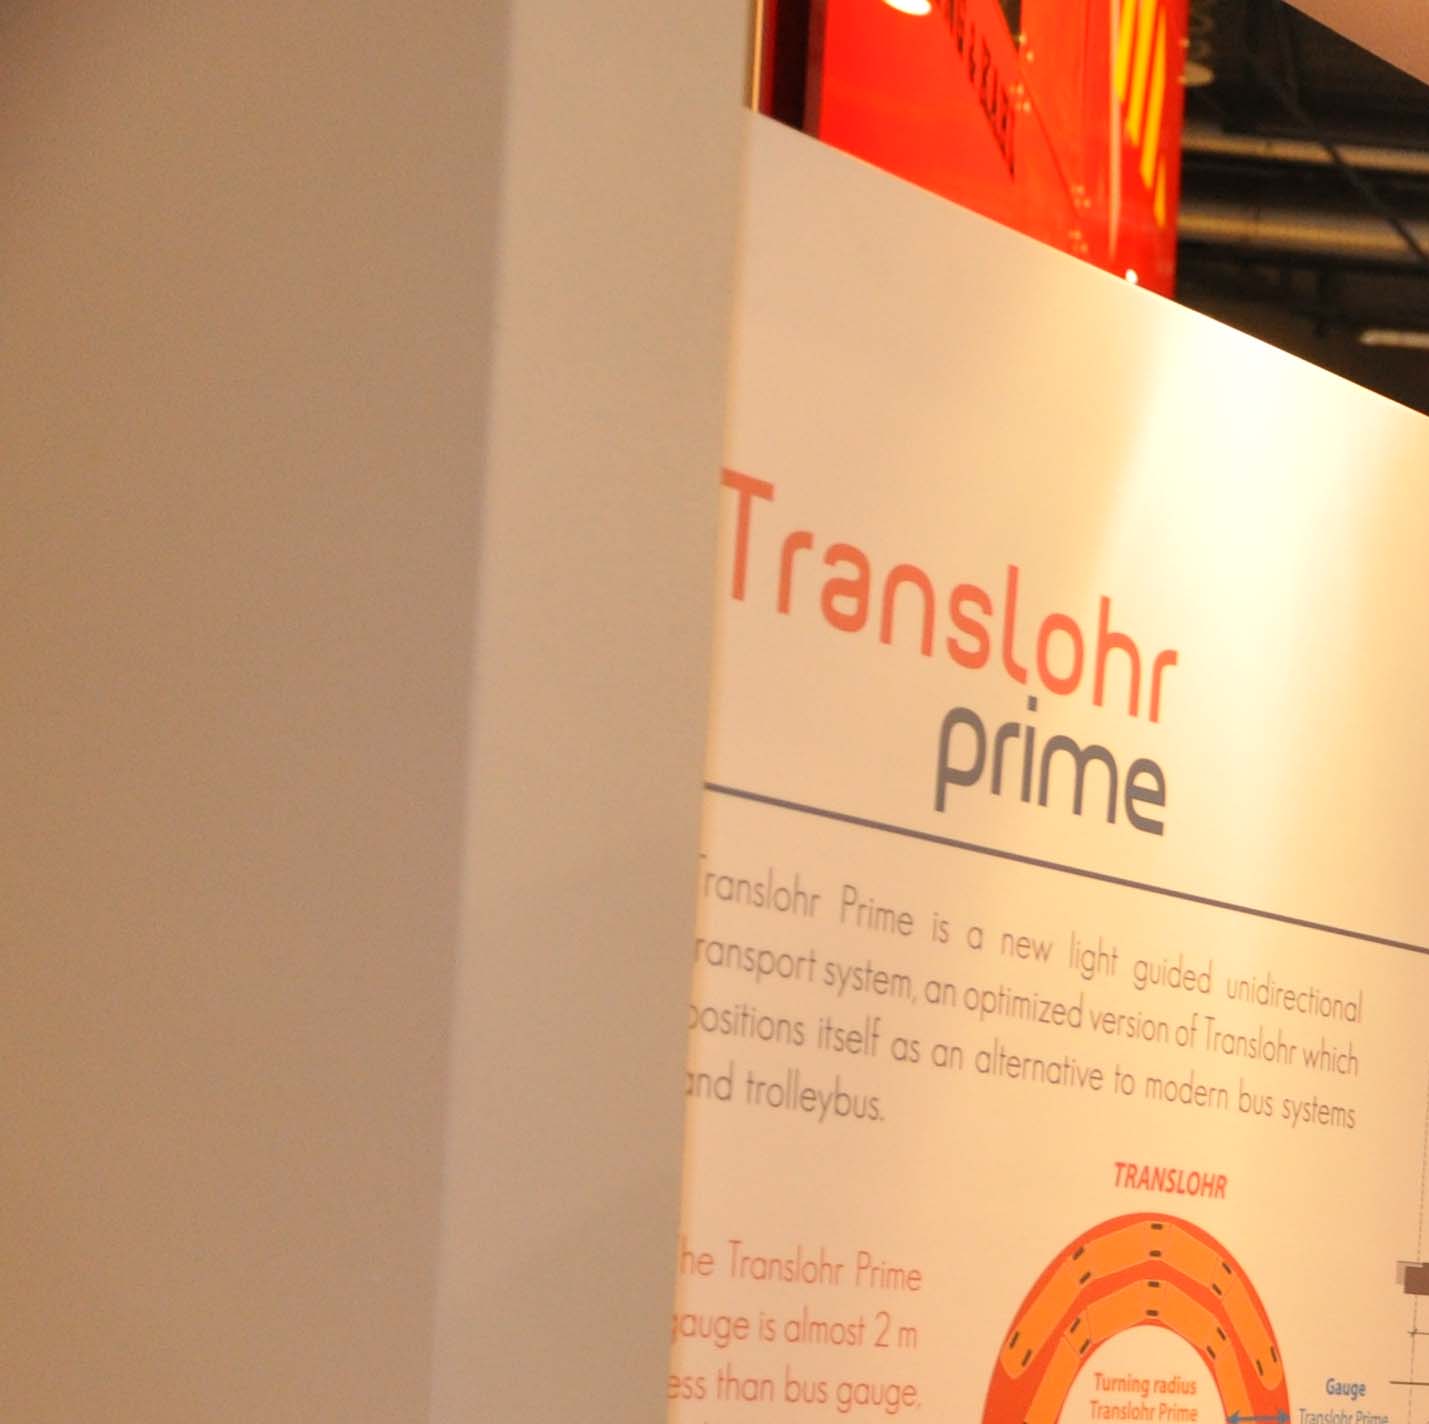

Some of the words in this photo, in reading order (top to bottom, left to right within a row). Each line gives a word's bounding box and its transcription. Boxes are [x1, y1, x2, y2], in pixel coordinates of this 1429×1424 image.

[720, 465, 1179, 724] Translohr
[933, 695, 1168, 836] prime
[699, 853, 822, 918] ranslohr
[840, 884, 914, 937] Prime
[931, 911, 951, 944] is
[966, 926, 984, 951] a
[1000, 931, 1053, 961] new
[1069, 929, 1119, 981] light
[1133, 952, 1214, 995] guided
[1226, 971, 1364, 1024] unidirectional
[823, 959, 917, 1004] system,
[924, 979, 957, 1008] an
[963, 986, 1084, 1028] optimized
[1088, 1009, 1170, 1043] version
[1175, 1012, 1199, 1049] of
[1204, 1016, 1298, 1065] Translohr
[1302, 1035, 1359, 1077] which
[746, 1068, 885, 1124] trolleybus.
[817, 1016, 882, 1057] itself
[891, 1036, 921, 1064] as
[931, 1043, 963, 1071] an
[974, 1037, 1104, 1091] alternative
[1113, 1063, 1136, 1096] to
[1144, 1068, 1229, 1112] modern
[1238, 1077, 1273, 1117] bus
[1281, 1096, 1357, 1129] systems
[1113, 1161, 1229, 1199] TRANSLOHR
[728, 1239, 844, 1287] Translohr
[855, 1250, 922, 1292] Prime
[758, 1312, 776, 1342] is
[783, 1305, 866, 1348] almost
[874, 1310, 890, 1348] 2
[897, 1325, 919, 1349] m
[716, 1362, 774, 1402] than
[784, 1363, 828, 1405] bus
[1093, 1372, 1151, 1398] Turning
[1153, 1376, 1197, 1395] radius
[1325, 1378, 1367, 1399] Gauge
[1090, 1400, 1155, 1421] Translohr
[1159, 1402, 1198, 1422] Prime
